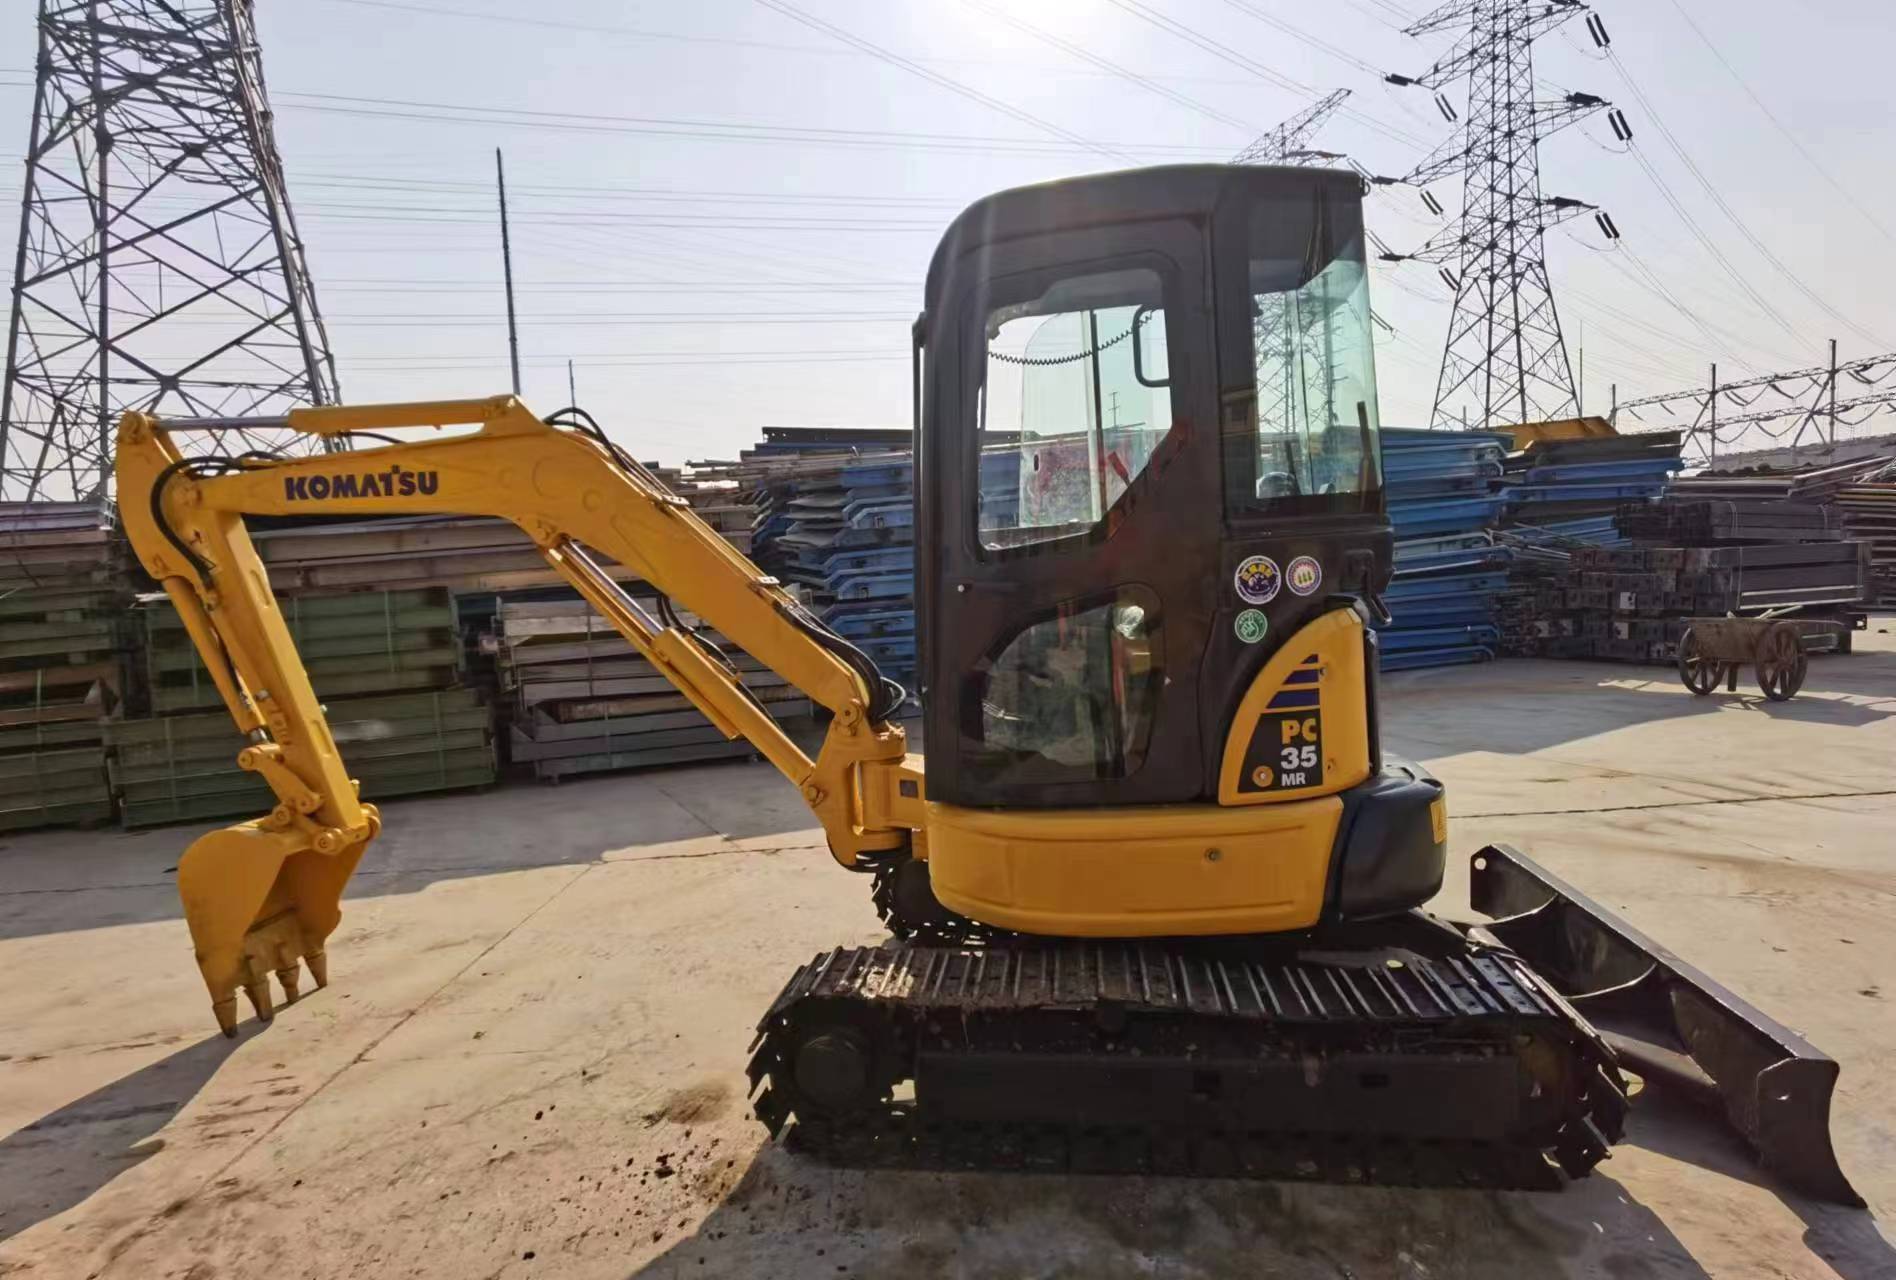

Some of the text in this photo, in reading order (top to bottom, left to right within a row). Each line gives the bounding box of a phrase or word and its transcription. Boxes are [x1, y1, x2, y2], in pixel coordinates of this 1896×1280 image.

[285, 465, 438, 500] KOMATSU
[1282, 719, 1317, 745] PC
[1281, 746, 1317, 769] 35
[1281, 773, 1306, 786] MR
